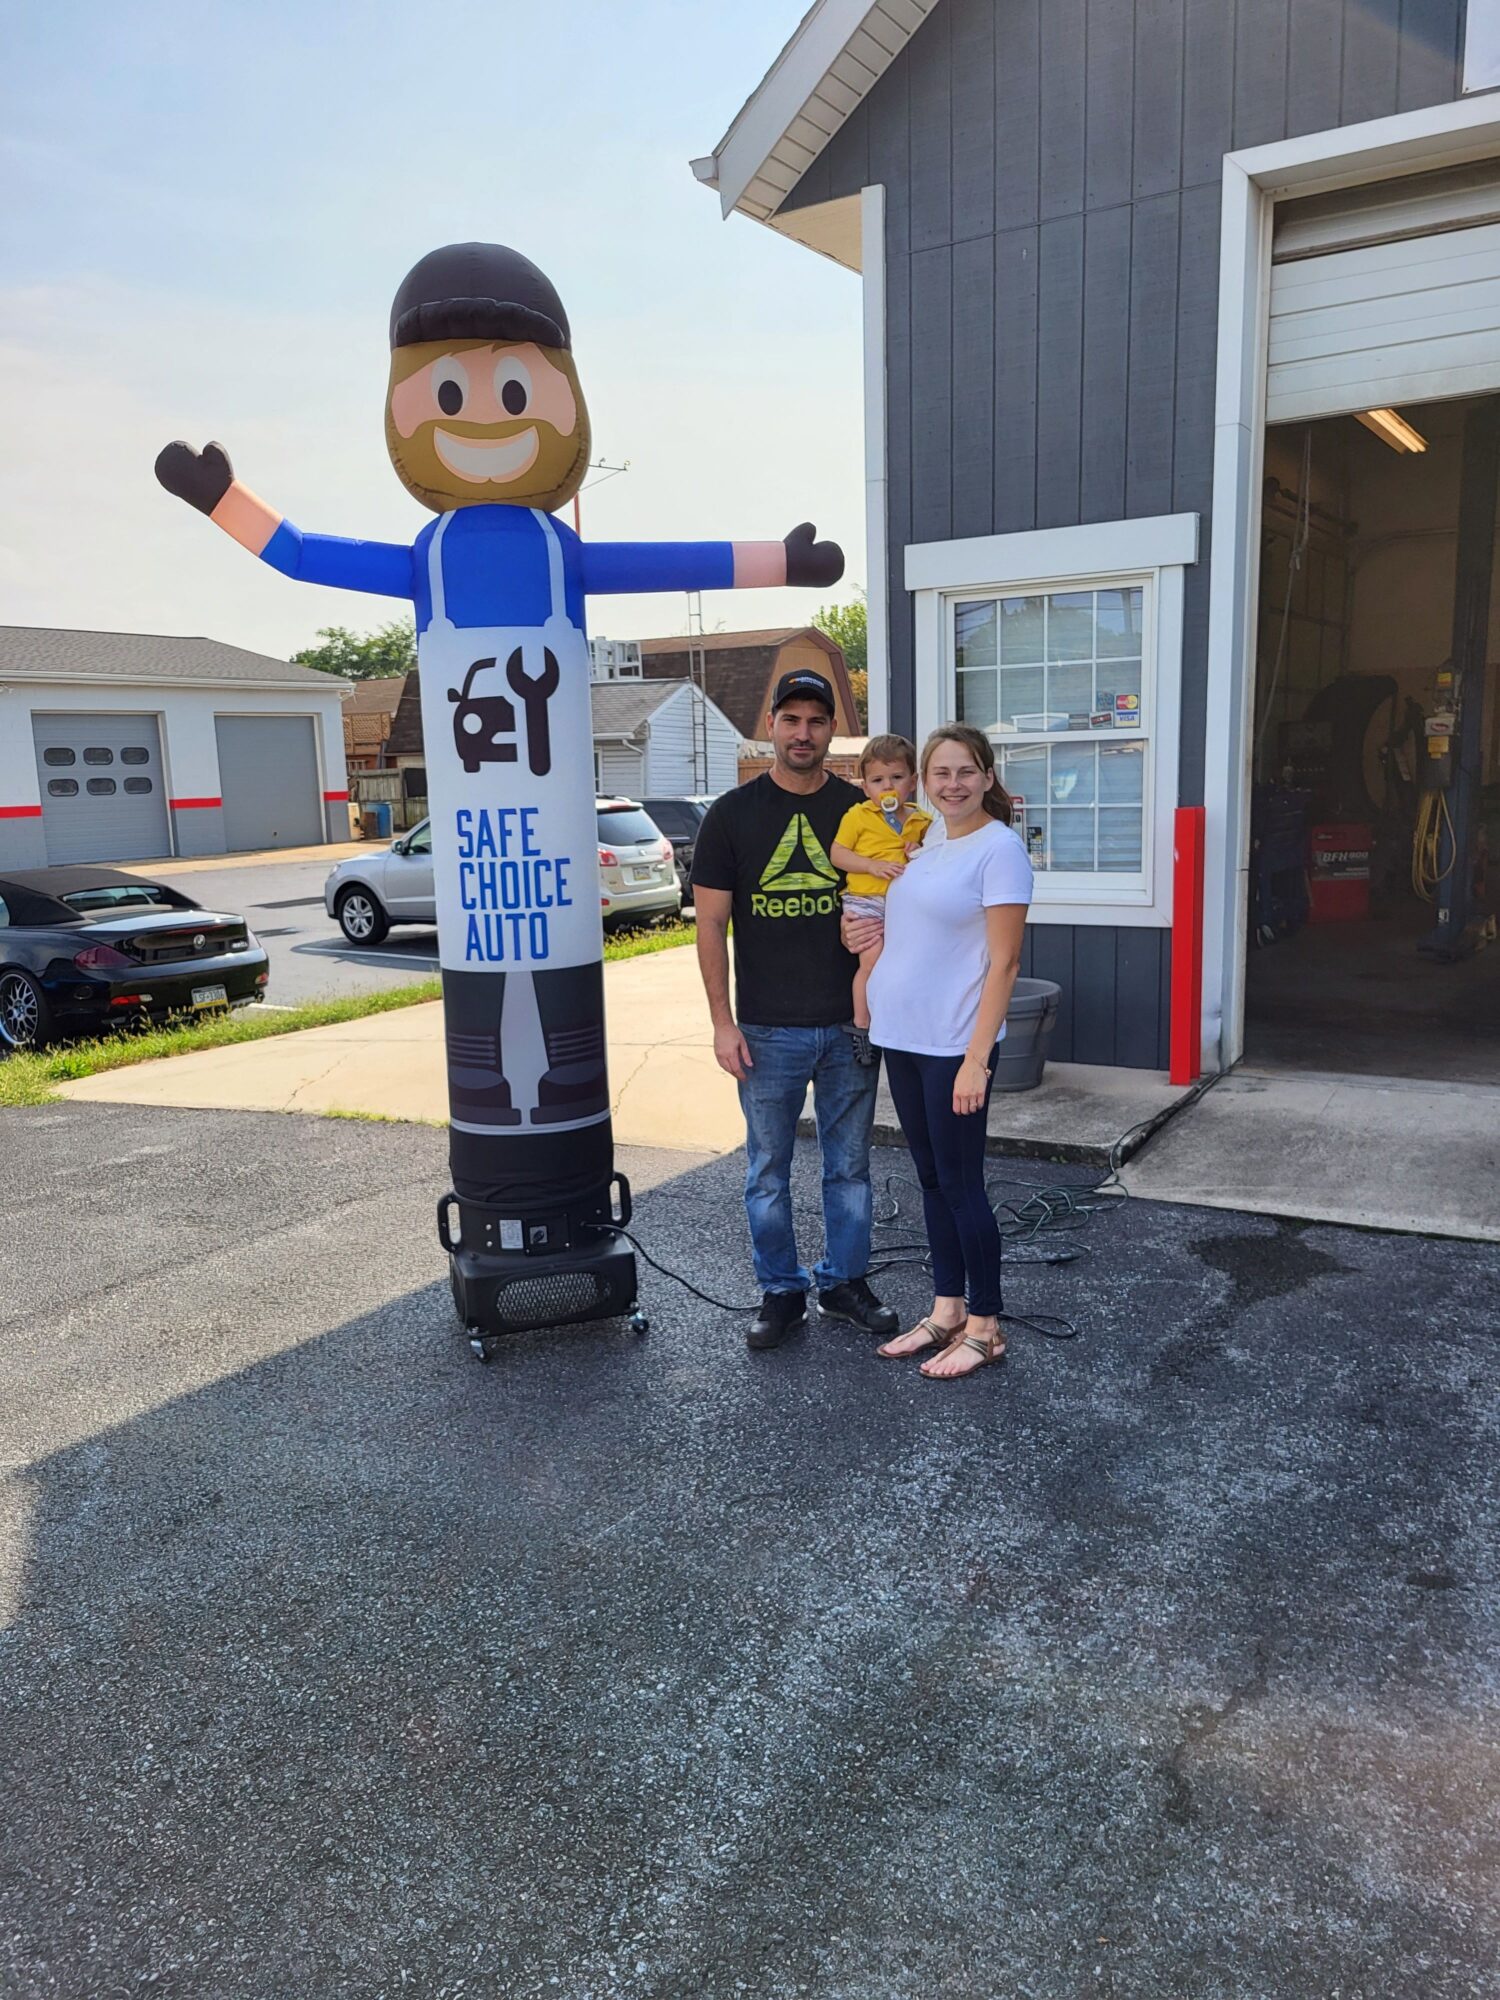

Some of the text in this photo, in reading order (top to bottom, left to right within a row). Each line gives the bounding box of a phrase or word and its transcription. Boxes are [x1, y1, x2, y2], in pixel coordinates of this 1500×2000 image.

[1119, 714, 1135, 722] VISA
[456, 807, 541, 858] SAFE
[459, 858, 573, 910] CHOICE
[465, 912, 549, 961] AUTO
